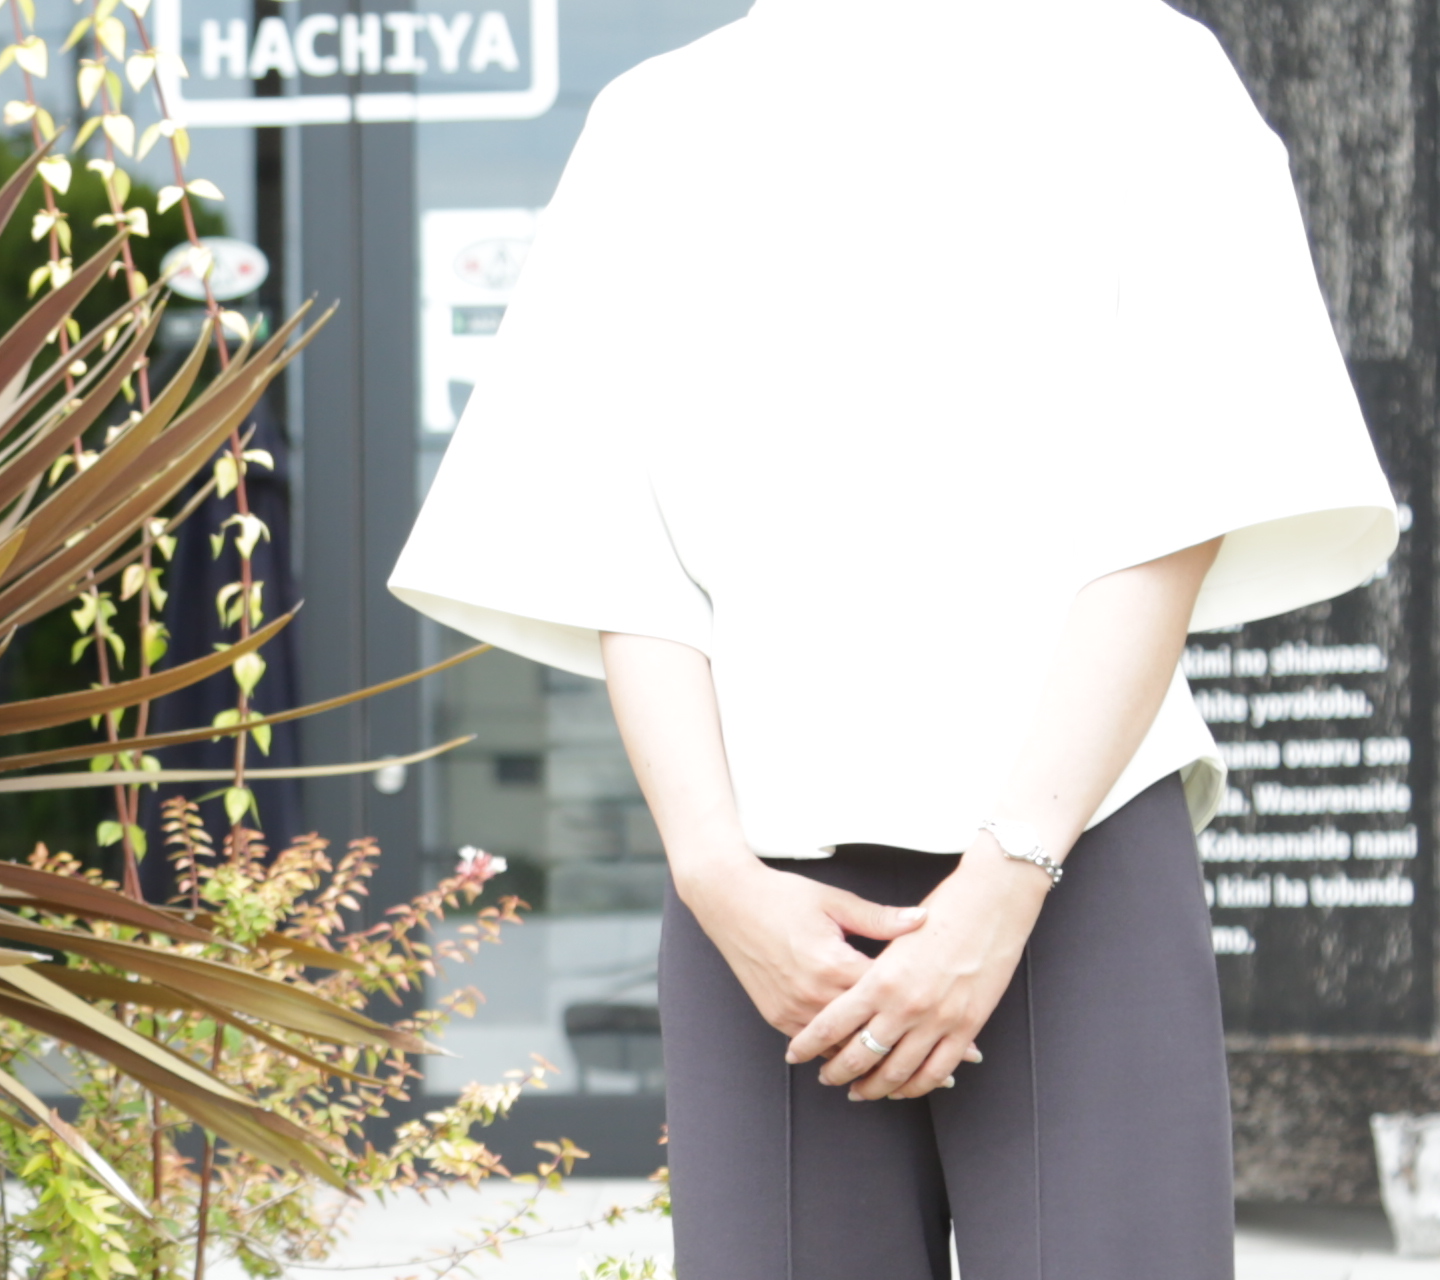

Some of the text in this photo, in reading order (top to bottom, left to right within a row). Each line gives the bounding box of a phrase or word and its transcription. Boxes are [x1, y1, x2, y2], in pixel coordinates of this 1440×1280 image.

[200, 11, 519, 79] HACHIYA
[1233, 649, 1267, 677] no
[1270, 640, 1388, 677] shiawase.
[1193, 684, 1373, 729] hite yorokobu.
[1282, 738, 1360, 769] owaru
[1363, 737, 1411, 767] son
[1252, 779, 1411, 815] Wasurenaide
[1354, 823, 1418, 860] nami
[1216, 873, 1270, 908] kimi
[1273, 873, 1308, 907] ha
[1310, 871, 1414, 907] tobunda
